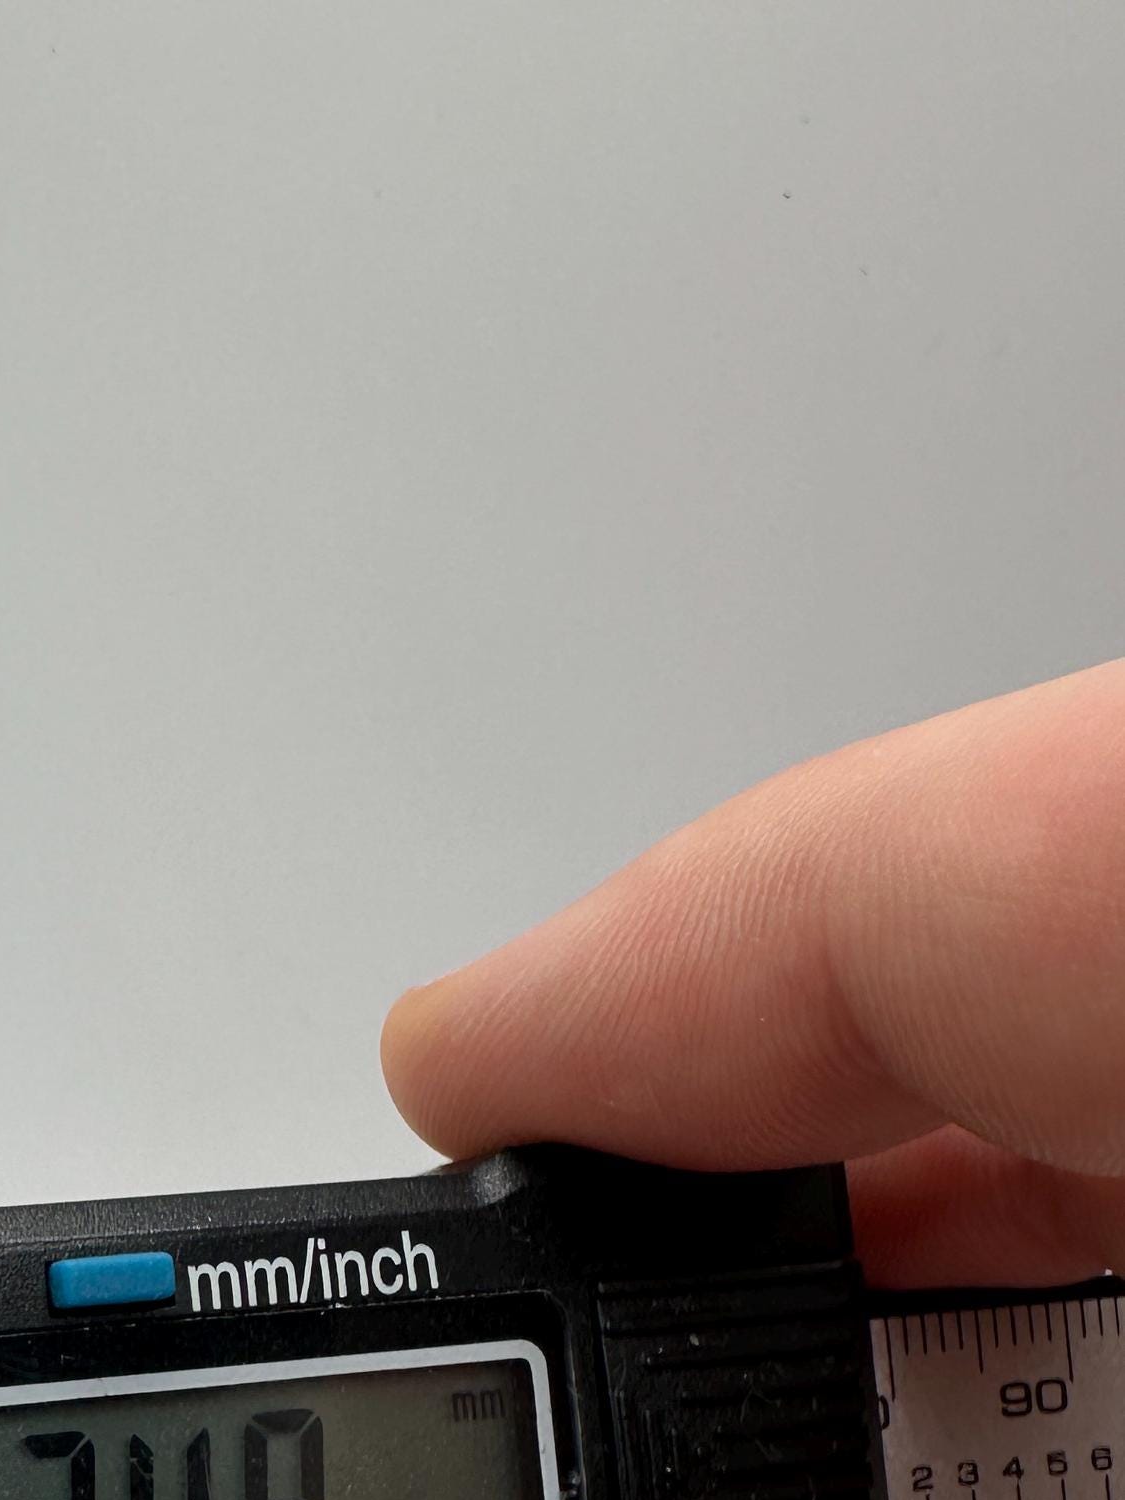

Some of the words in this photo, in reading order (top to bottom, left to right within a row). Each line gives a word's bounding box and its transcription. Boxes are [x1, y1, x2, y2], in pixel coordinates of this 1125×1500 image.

[187, 1231, 440, 1312] mm/inch
[452, 1391, 507, 1423] mm
[1000, 1378, 1068, 1418] 90
[911, 1465, 933, 1493] 2
[1003, 1456, 1024, 1480] 4
[1047, 1450, 1068, 1476] 5
[1091, 1447, 1112, 1471] 6
